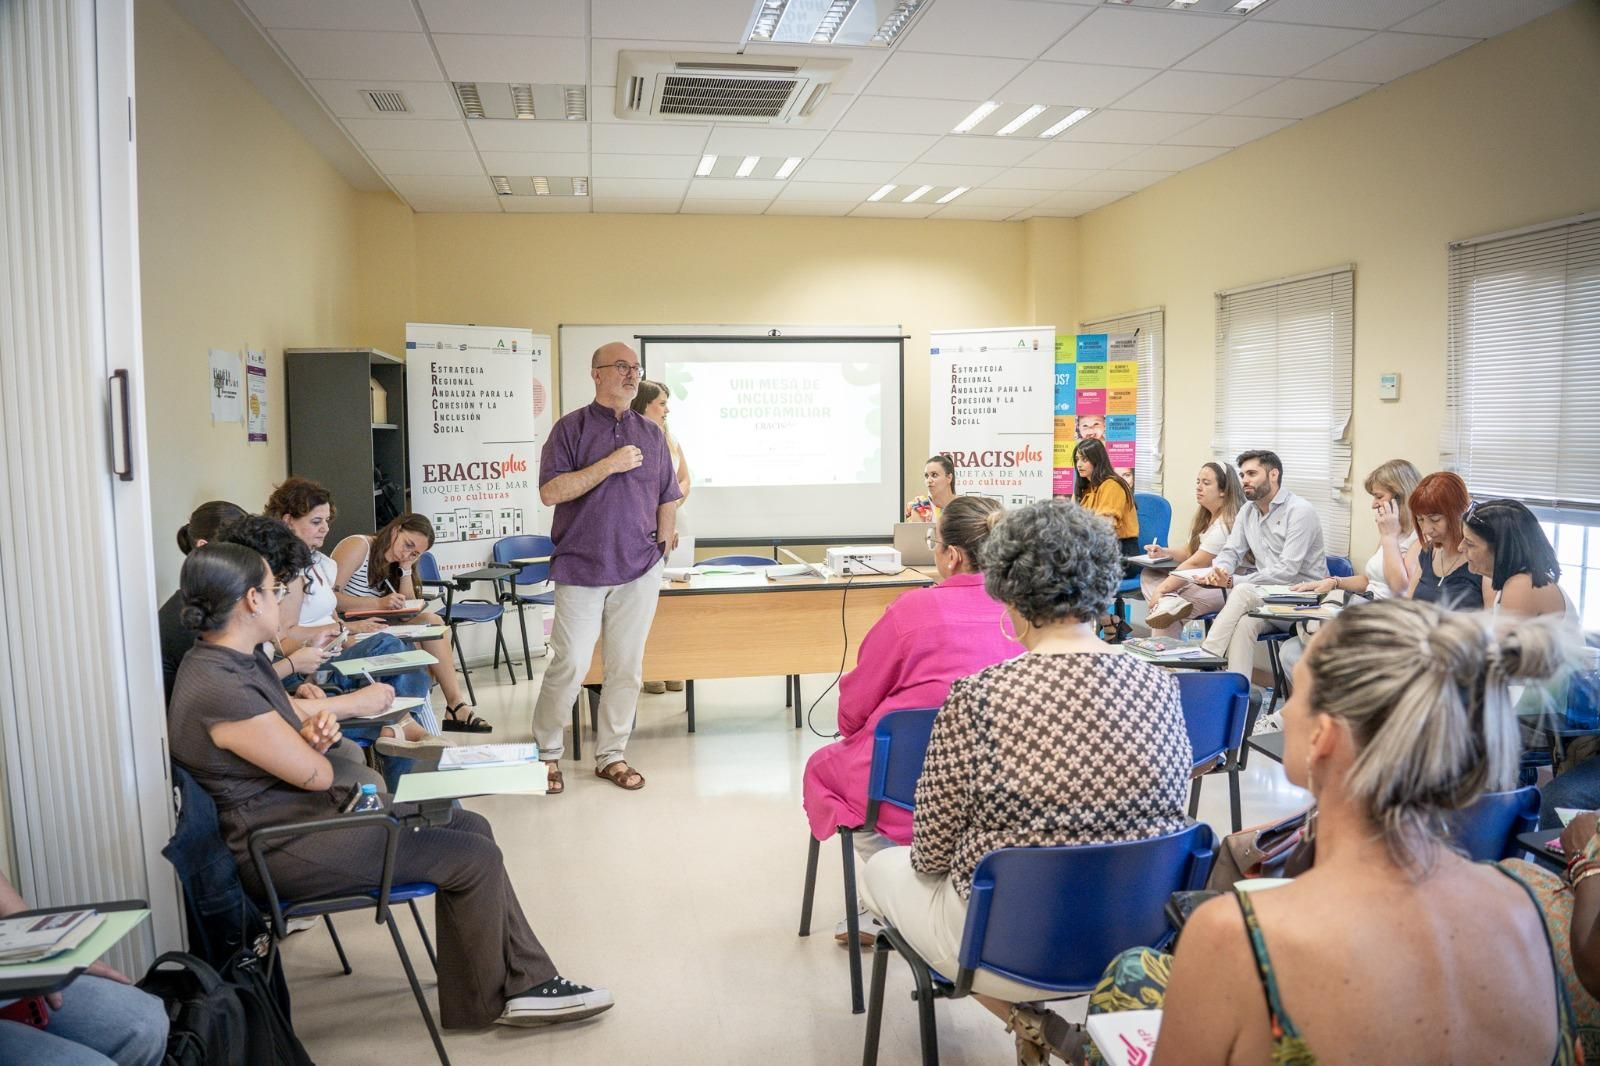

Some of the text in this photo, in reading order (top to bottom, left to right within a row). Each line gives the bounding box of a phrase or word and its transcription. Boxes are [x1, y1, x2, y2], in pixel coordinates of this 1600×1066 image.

[759, 377, 799, 390] MESA
[802, 378, 821, 390] DE
[1022, 385, 1033, 393] LA
[480, 390, 501, 398] PARA
[720, 406, 832, 419] SOCIOFAMILIAR
[999, 470, 1014, 478] DE
[1019, 470, 1044, 478] MAR
[978, 478, 1023, 486] culturas
[422, 480, 529, 495] ROQUETAS DE MAR
[466, 491, 510, 501] culturas
